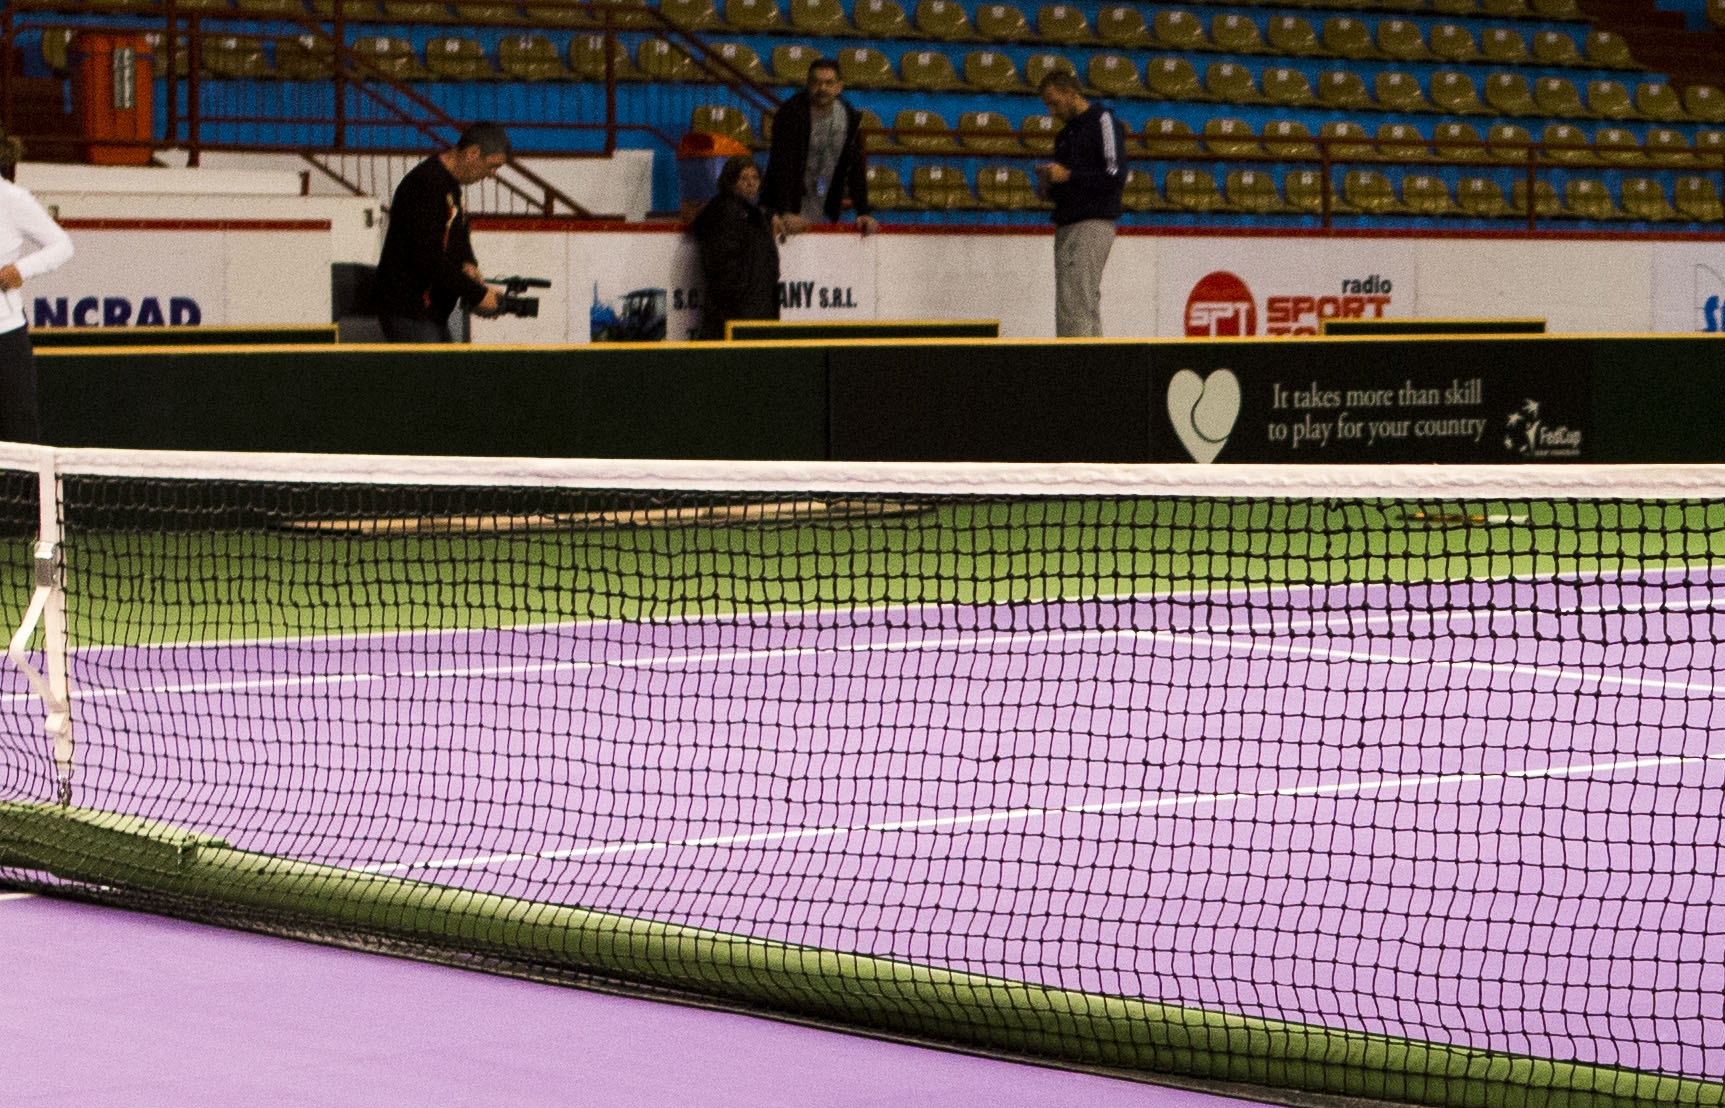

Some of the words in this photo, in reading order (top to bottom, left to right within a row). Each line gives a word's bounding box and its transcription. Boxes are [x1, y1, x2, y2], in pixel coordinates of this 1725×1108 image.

[778, 281, 815, 308] ANY
[1341, 274, 1392, 294] radio
[32, 296, 201, 327] NCRAD
[1266, 295, 1391, 322] SPORT
[1273, 383, 1288, 409] It
[1294, 381, 1341, 408] takes
[1346, 388, 1393, 407] more
[1399, 379, 1439, 405] than
[1445, 378, 1482, 404] skill
[1268, 422, 1287, 441] to
[1293, 413, 1332, 448] play
[1337, 412, 1364, 439] for
[1369, 420, 1411, 446] your
[1414, 418, 1487, 442] country
